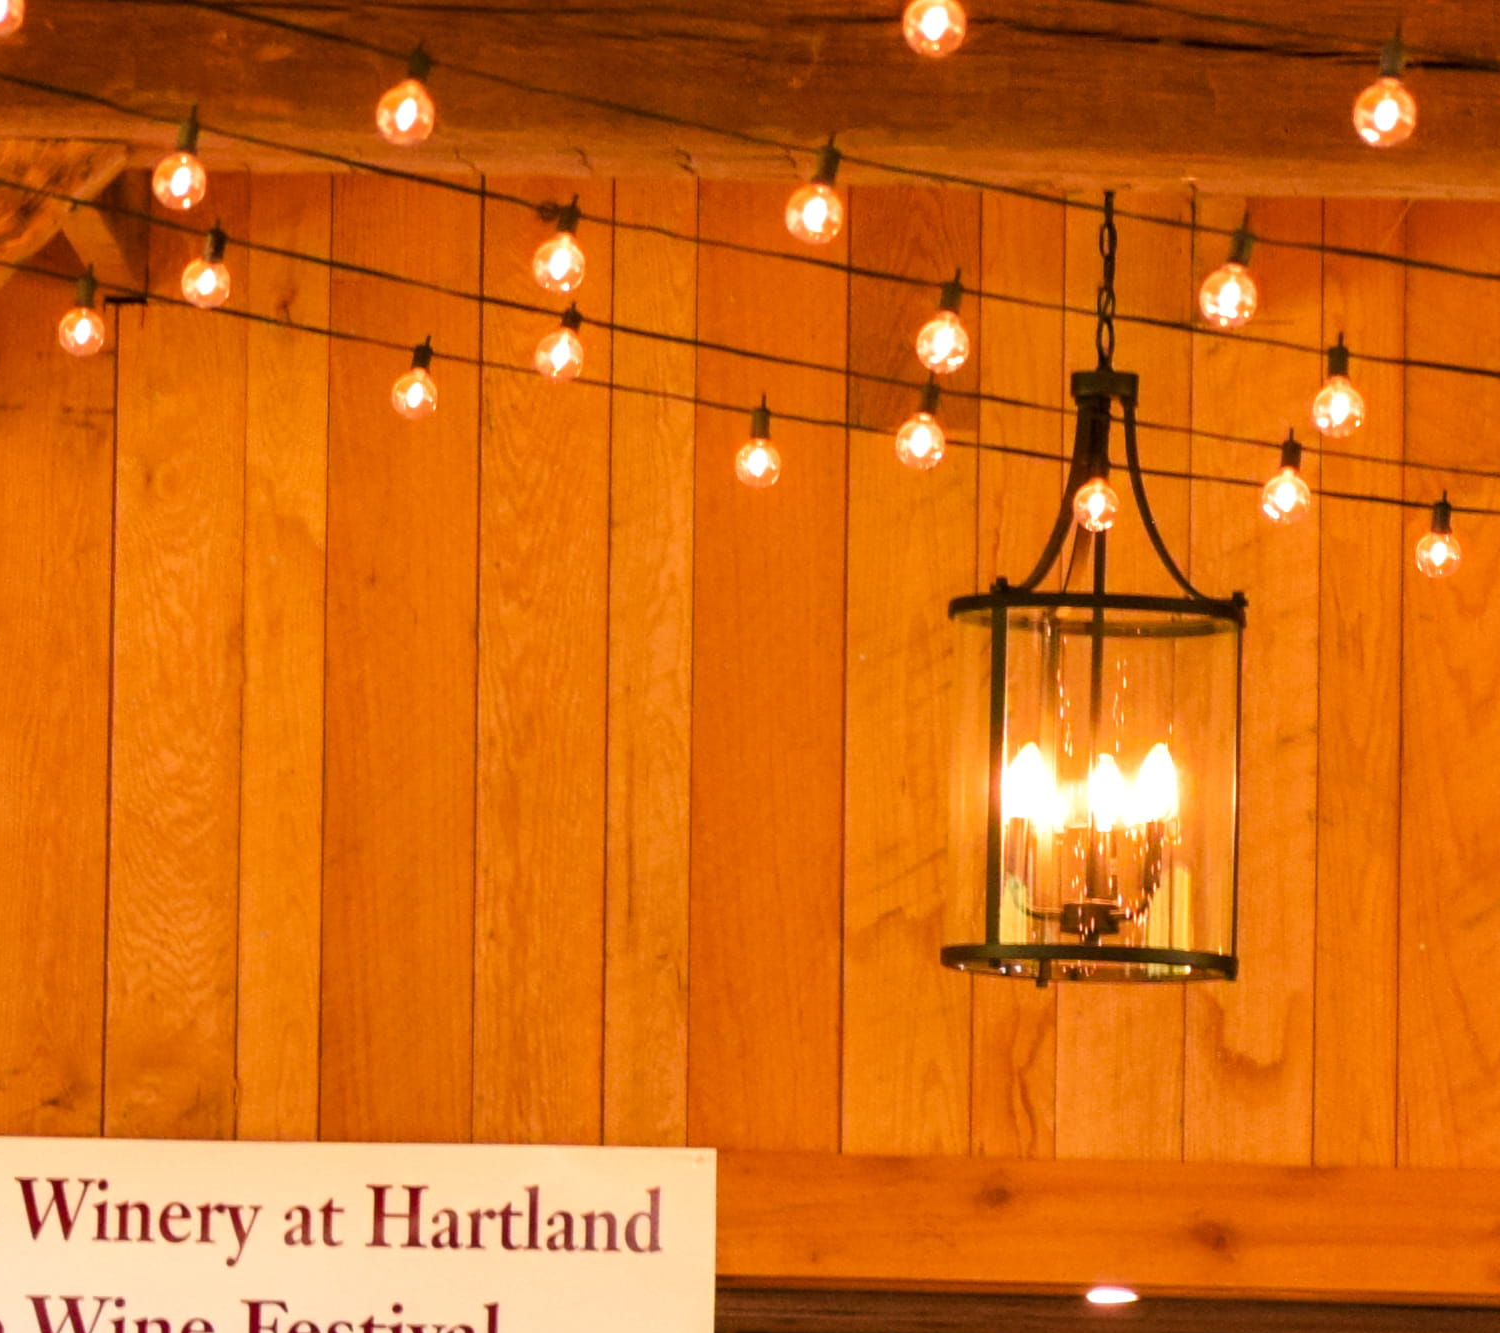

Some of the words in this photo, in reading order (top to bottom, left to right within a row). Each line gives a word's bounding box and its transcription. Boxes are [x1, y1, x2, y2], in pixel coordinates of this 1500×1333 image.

[15, 1177, 263, 1267] Winery
[284, 1197, 344, 1248] at
[366, 1184, 662, 1254] Hartland
